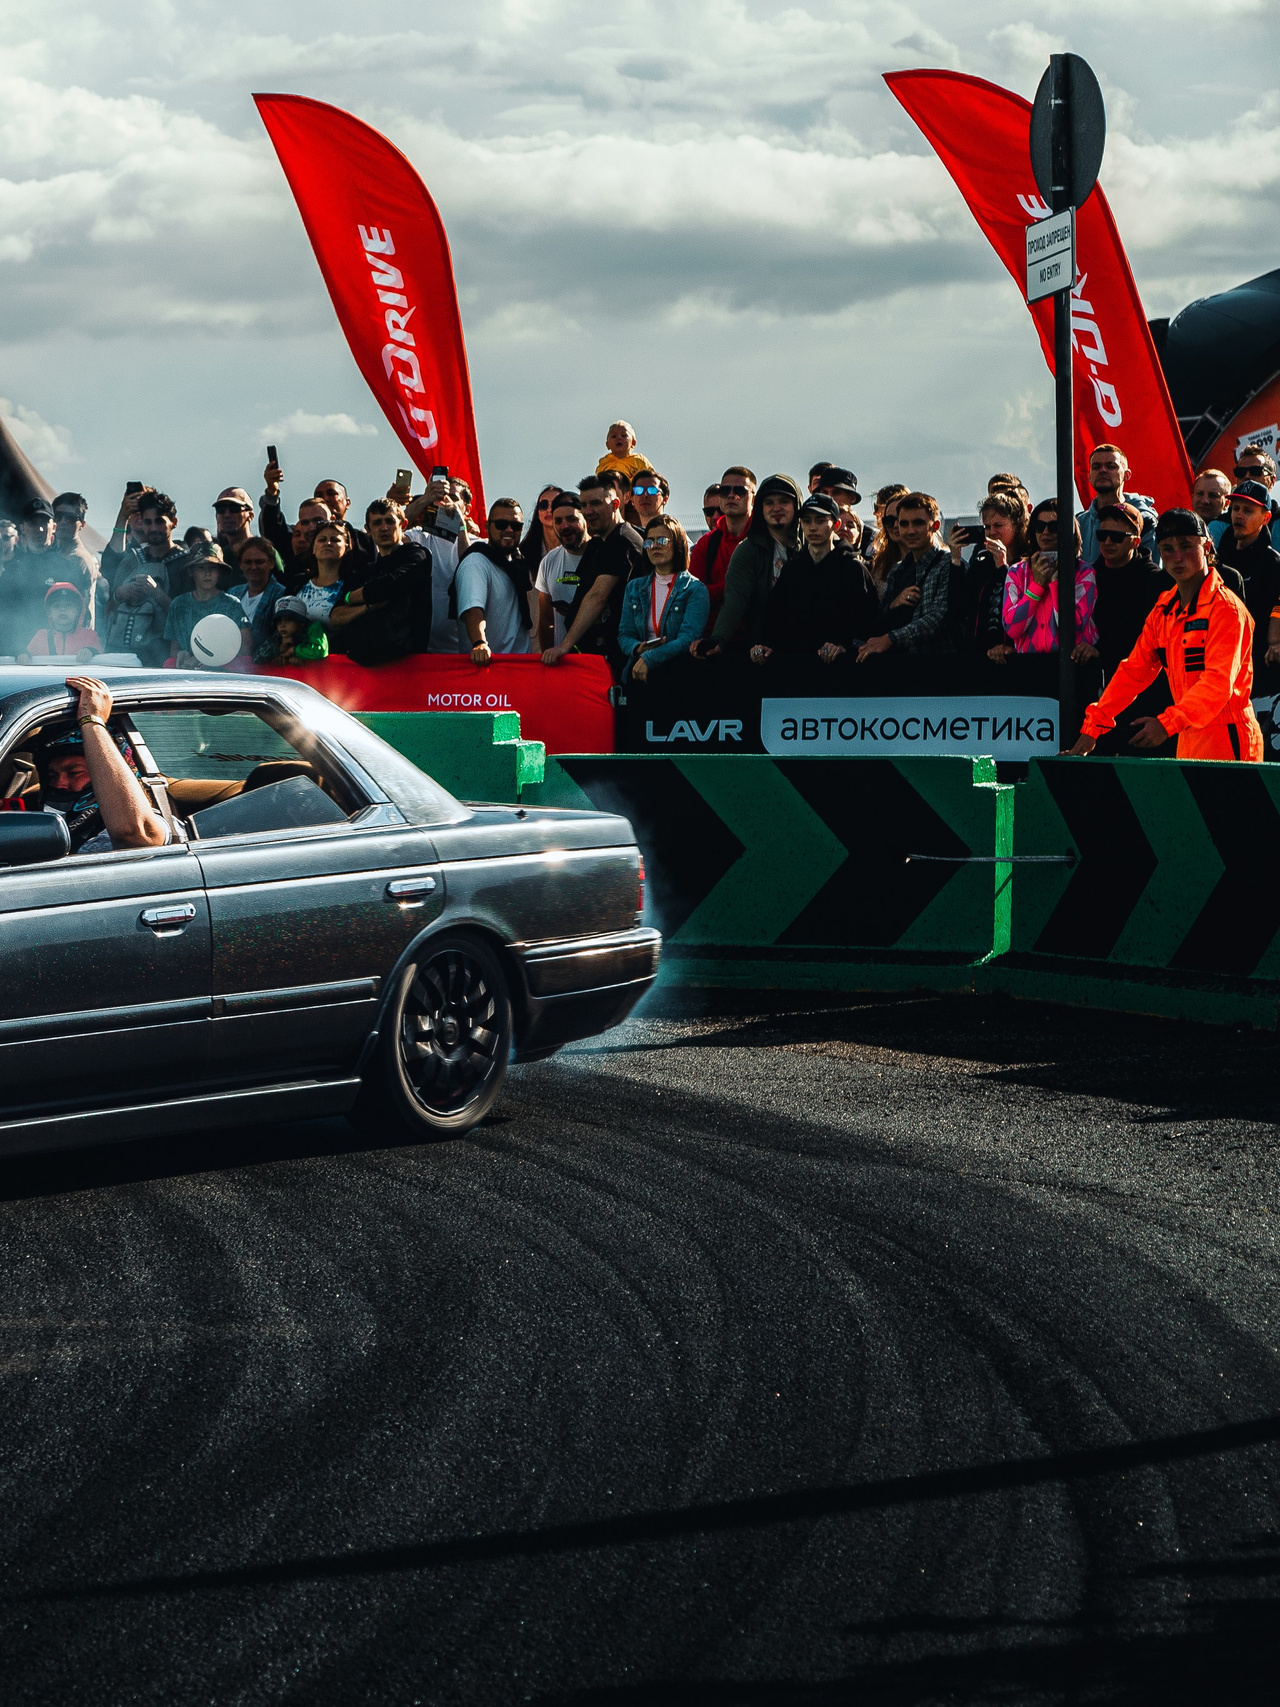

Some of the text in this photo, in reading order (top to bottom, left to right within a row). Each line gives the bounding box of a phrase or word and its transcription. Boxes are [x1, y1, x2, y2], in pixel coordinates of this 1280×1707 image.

[1028, 235, 1046, 255] ПРОХОД
[1040, 261, 1062, 283] NO ENTRY
[427, 693, 512, 707] MOTOR OIL
[645, 719, 743, 742] LAVR
[780, 716, 1055, 742] автокосметика
